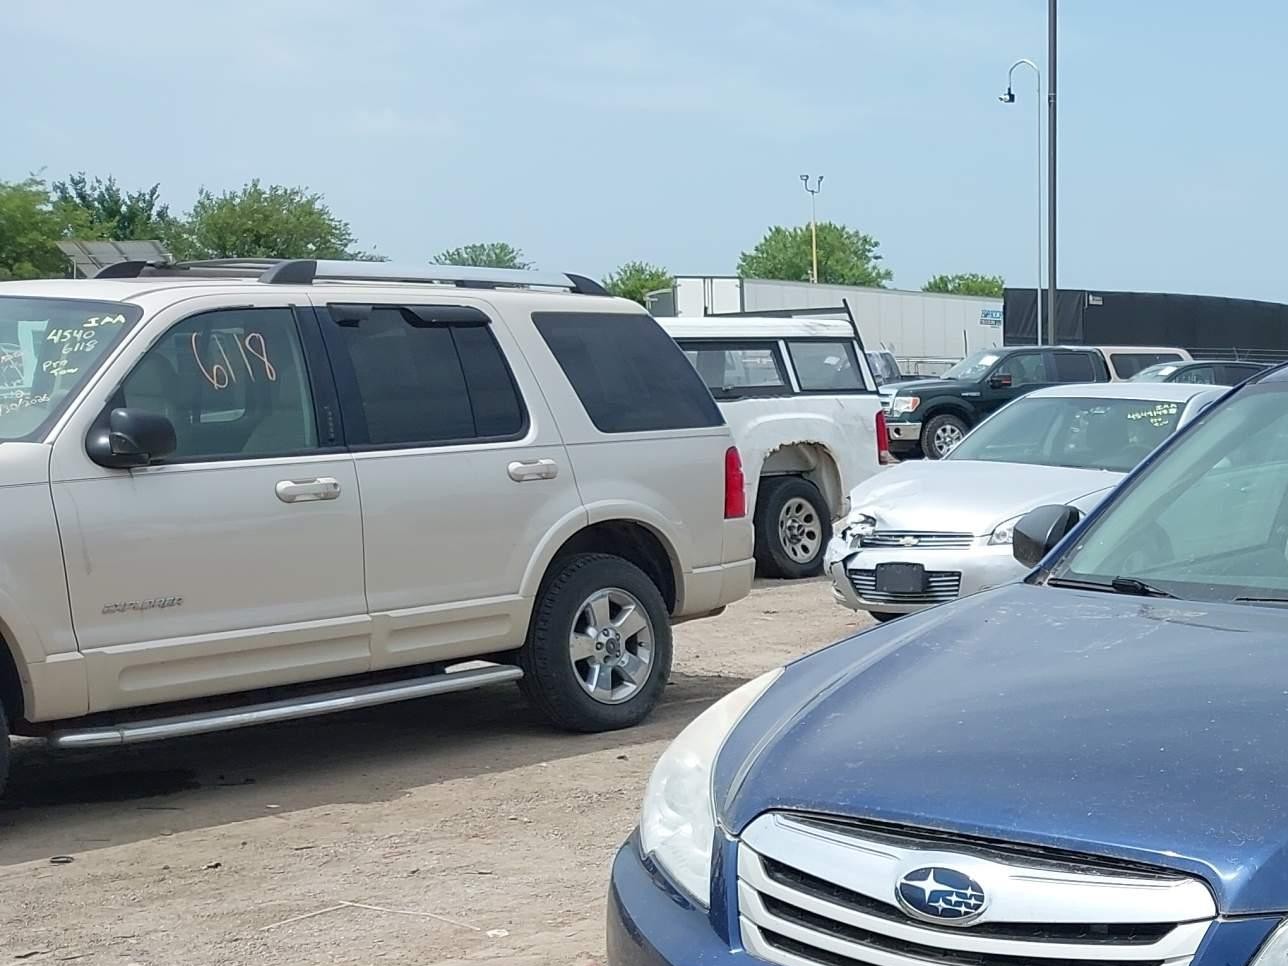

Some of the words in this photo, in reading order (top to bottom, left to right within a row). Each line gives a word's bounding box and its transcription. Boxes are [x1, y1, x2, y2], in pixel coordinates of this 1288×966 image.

[83, 314, 126, 328] IAA
[46, 328, 96, 343] 4540
[61, 339, 98, 354] 6118
[191, 332, 277, 390] 6118
